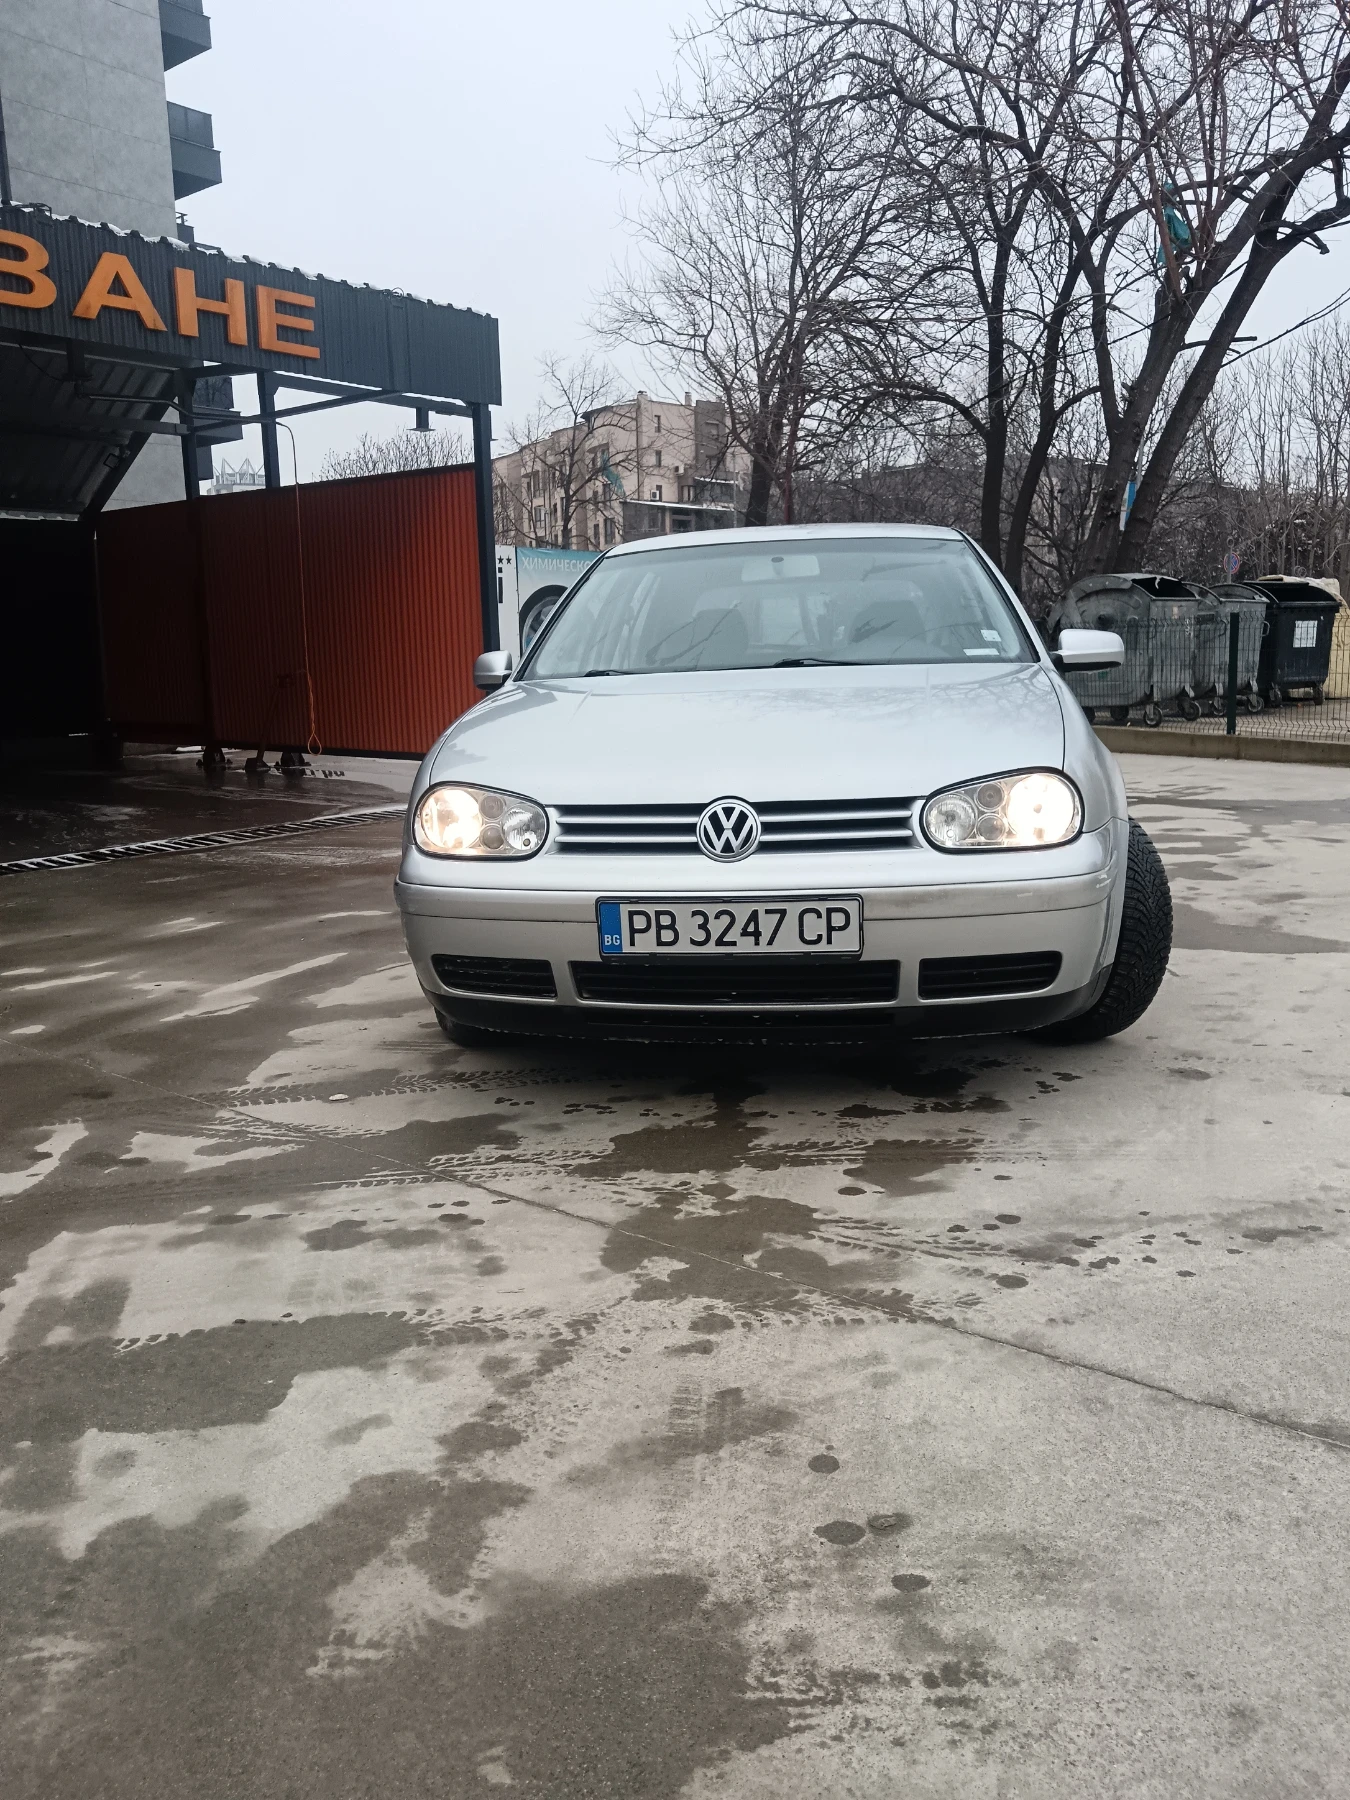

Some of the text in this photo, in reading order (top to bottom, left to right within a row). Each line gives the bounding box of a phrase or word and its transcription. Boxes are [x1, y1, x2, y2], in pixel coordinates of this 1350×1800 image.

[700, 803, 757, 856] VW
[604, 935, 621, 946] BG
[628, 907, 851, 947] PB 3247 CP
